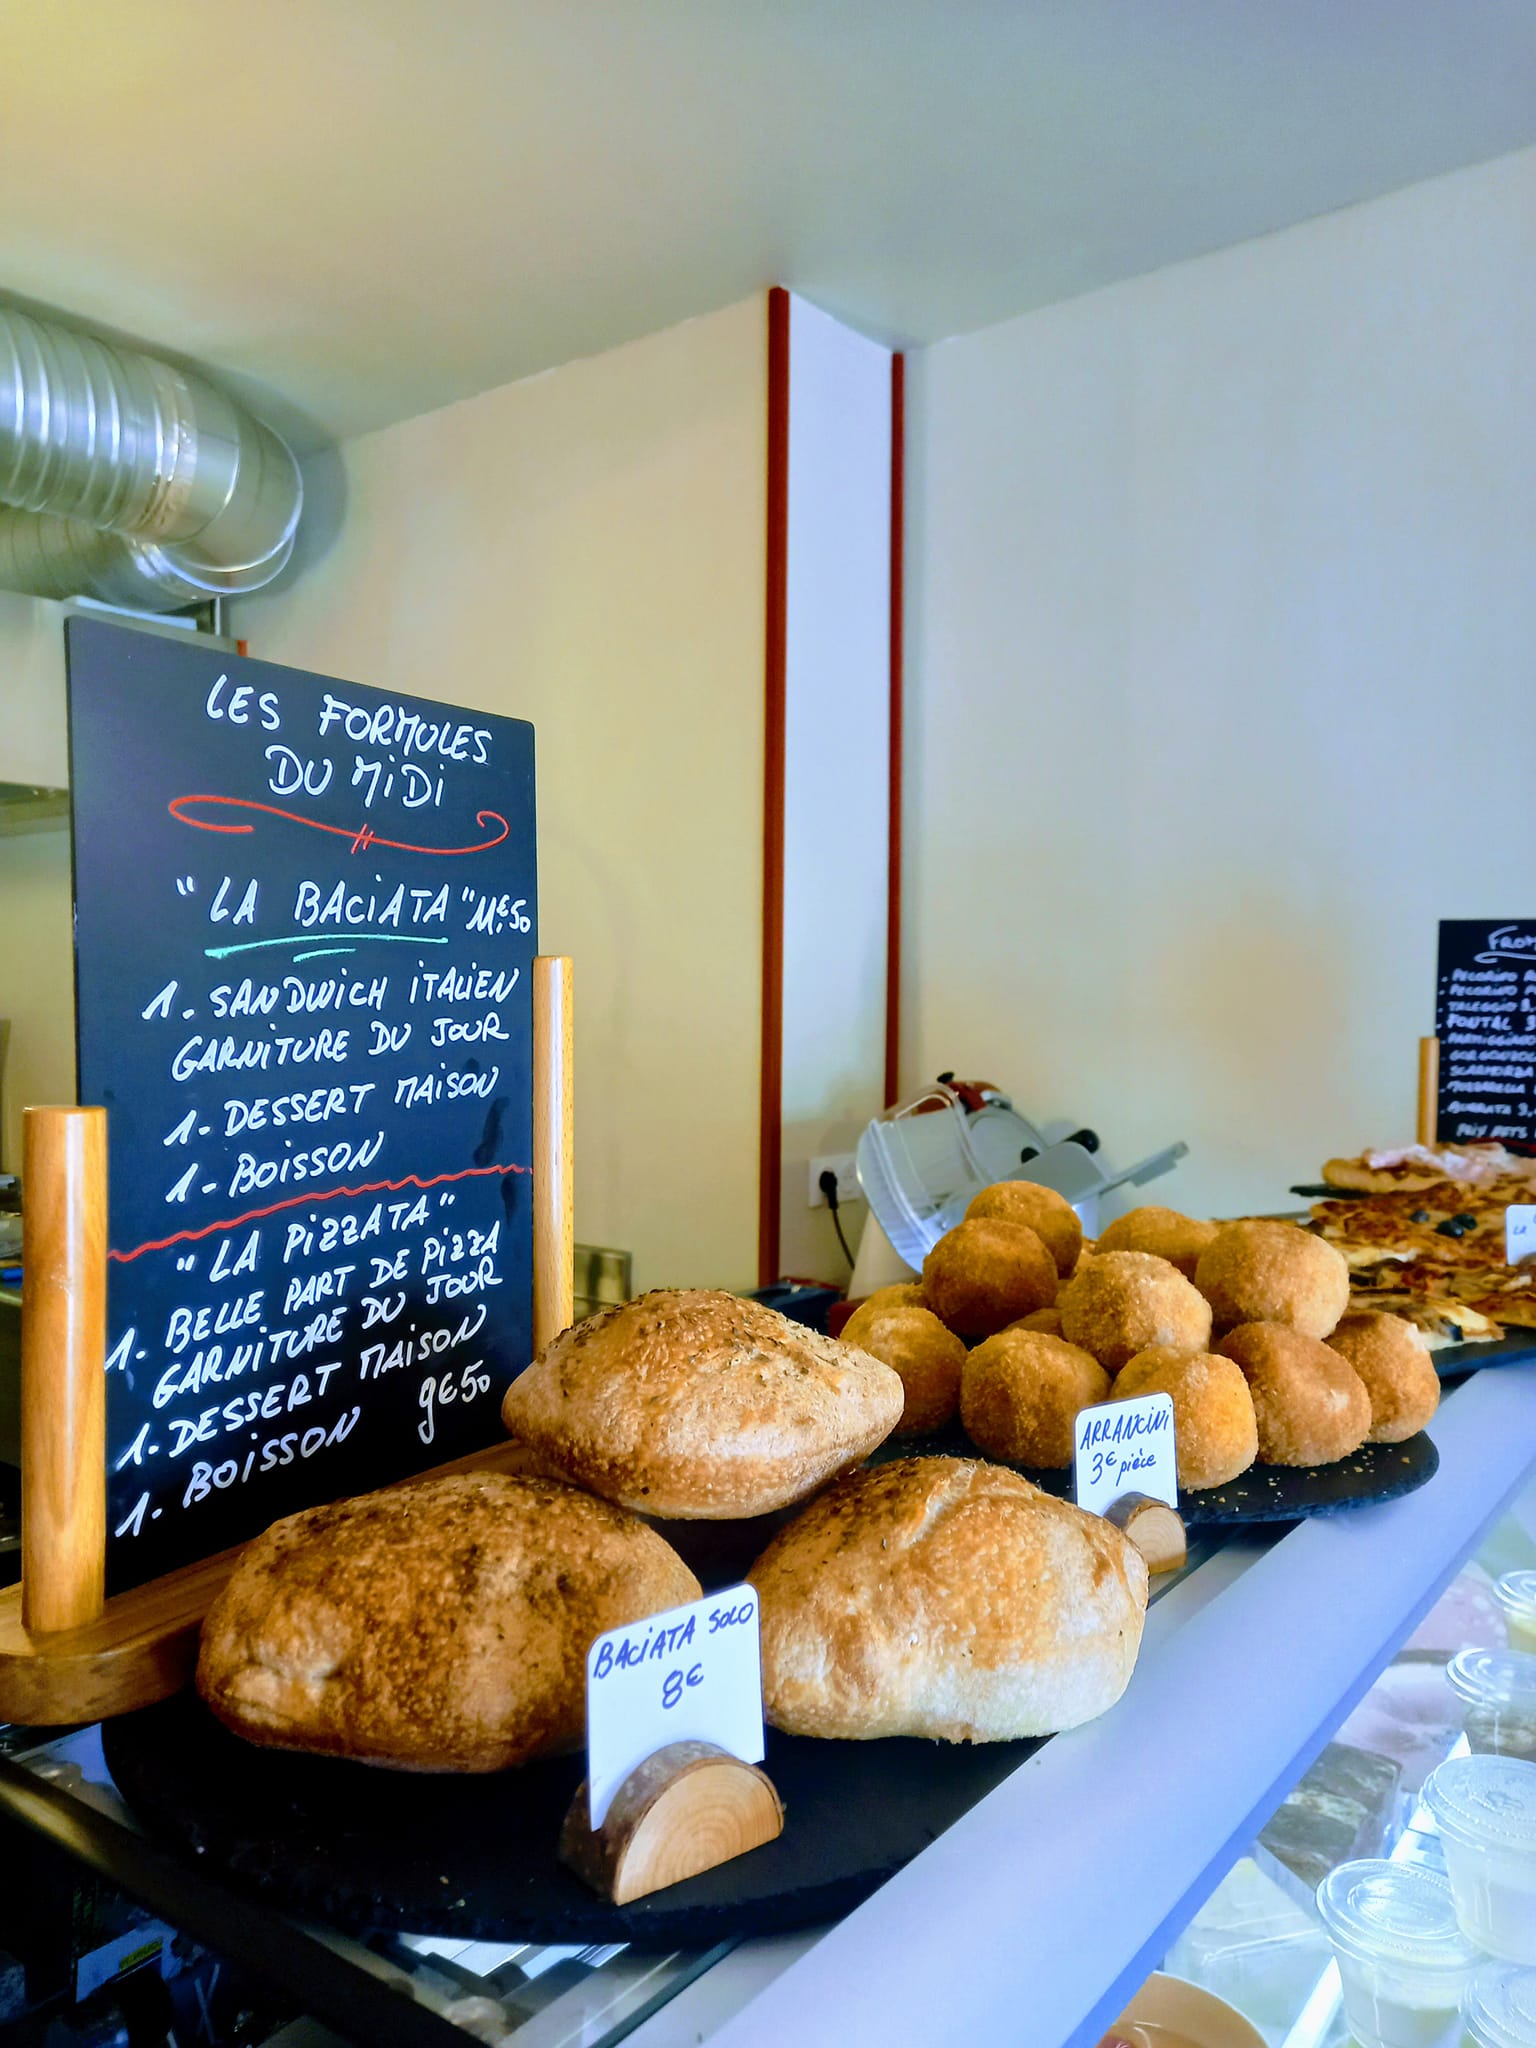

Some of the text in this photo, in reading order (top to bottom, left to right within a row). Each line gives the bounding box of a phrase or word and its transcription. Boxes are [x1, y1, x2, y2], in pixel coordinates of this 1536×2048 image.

[206, 674, 493, 765] LES FORMULES
[265, 745, 332, 796] DU
[368, 1021, 411, 1055] DU
[431, 1012, 510, 1043] JOUR
[224, 1083, 376, 1138] DESSERT
[165, 1290, 264, 1353] BELLE
[284, 1265, 355, 1316] PART
[370, 1248, 408, 1288] DE
[361, 1292, 405, 1331] DU
[426, 1257, 502, 1305] JOUR
[169, 1363, 342, 1457] DESSERT
[1090, 1448, 1157, 1487] 3€ pièce
[708, 1602, 754, 1634] SOLO
[661, 1662, 704, 1710] 8€
